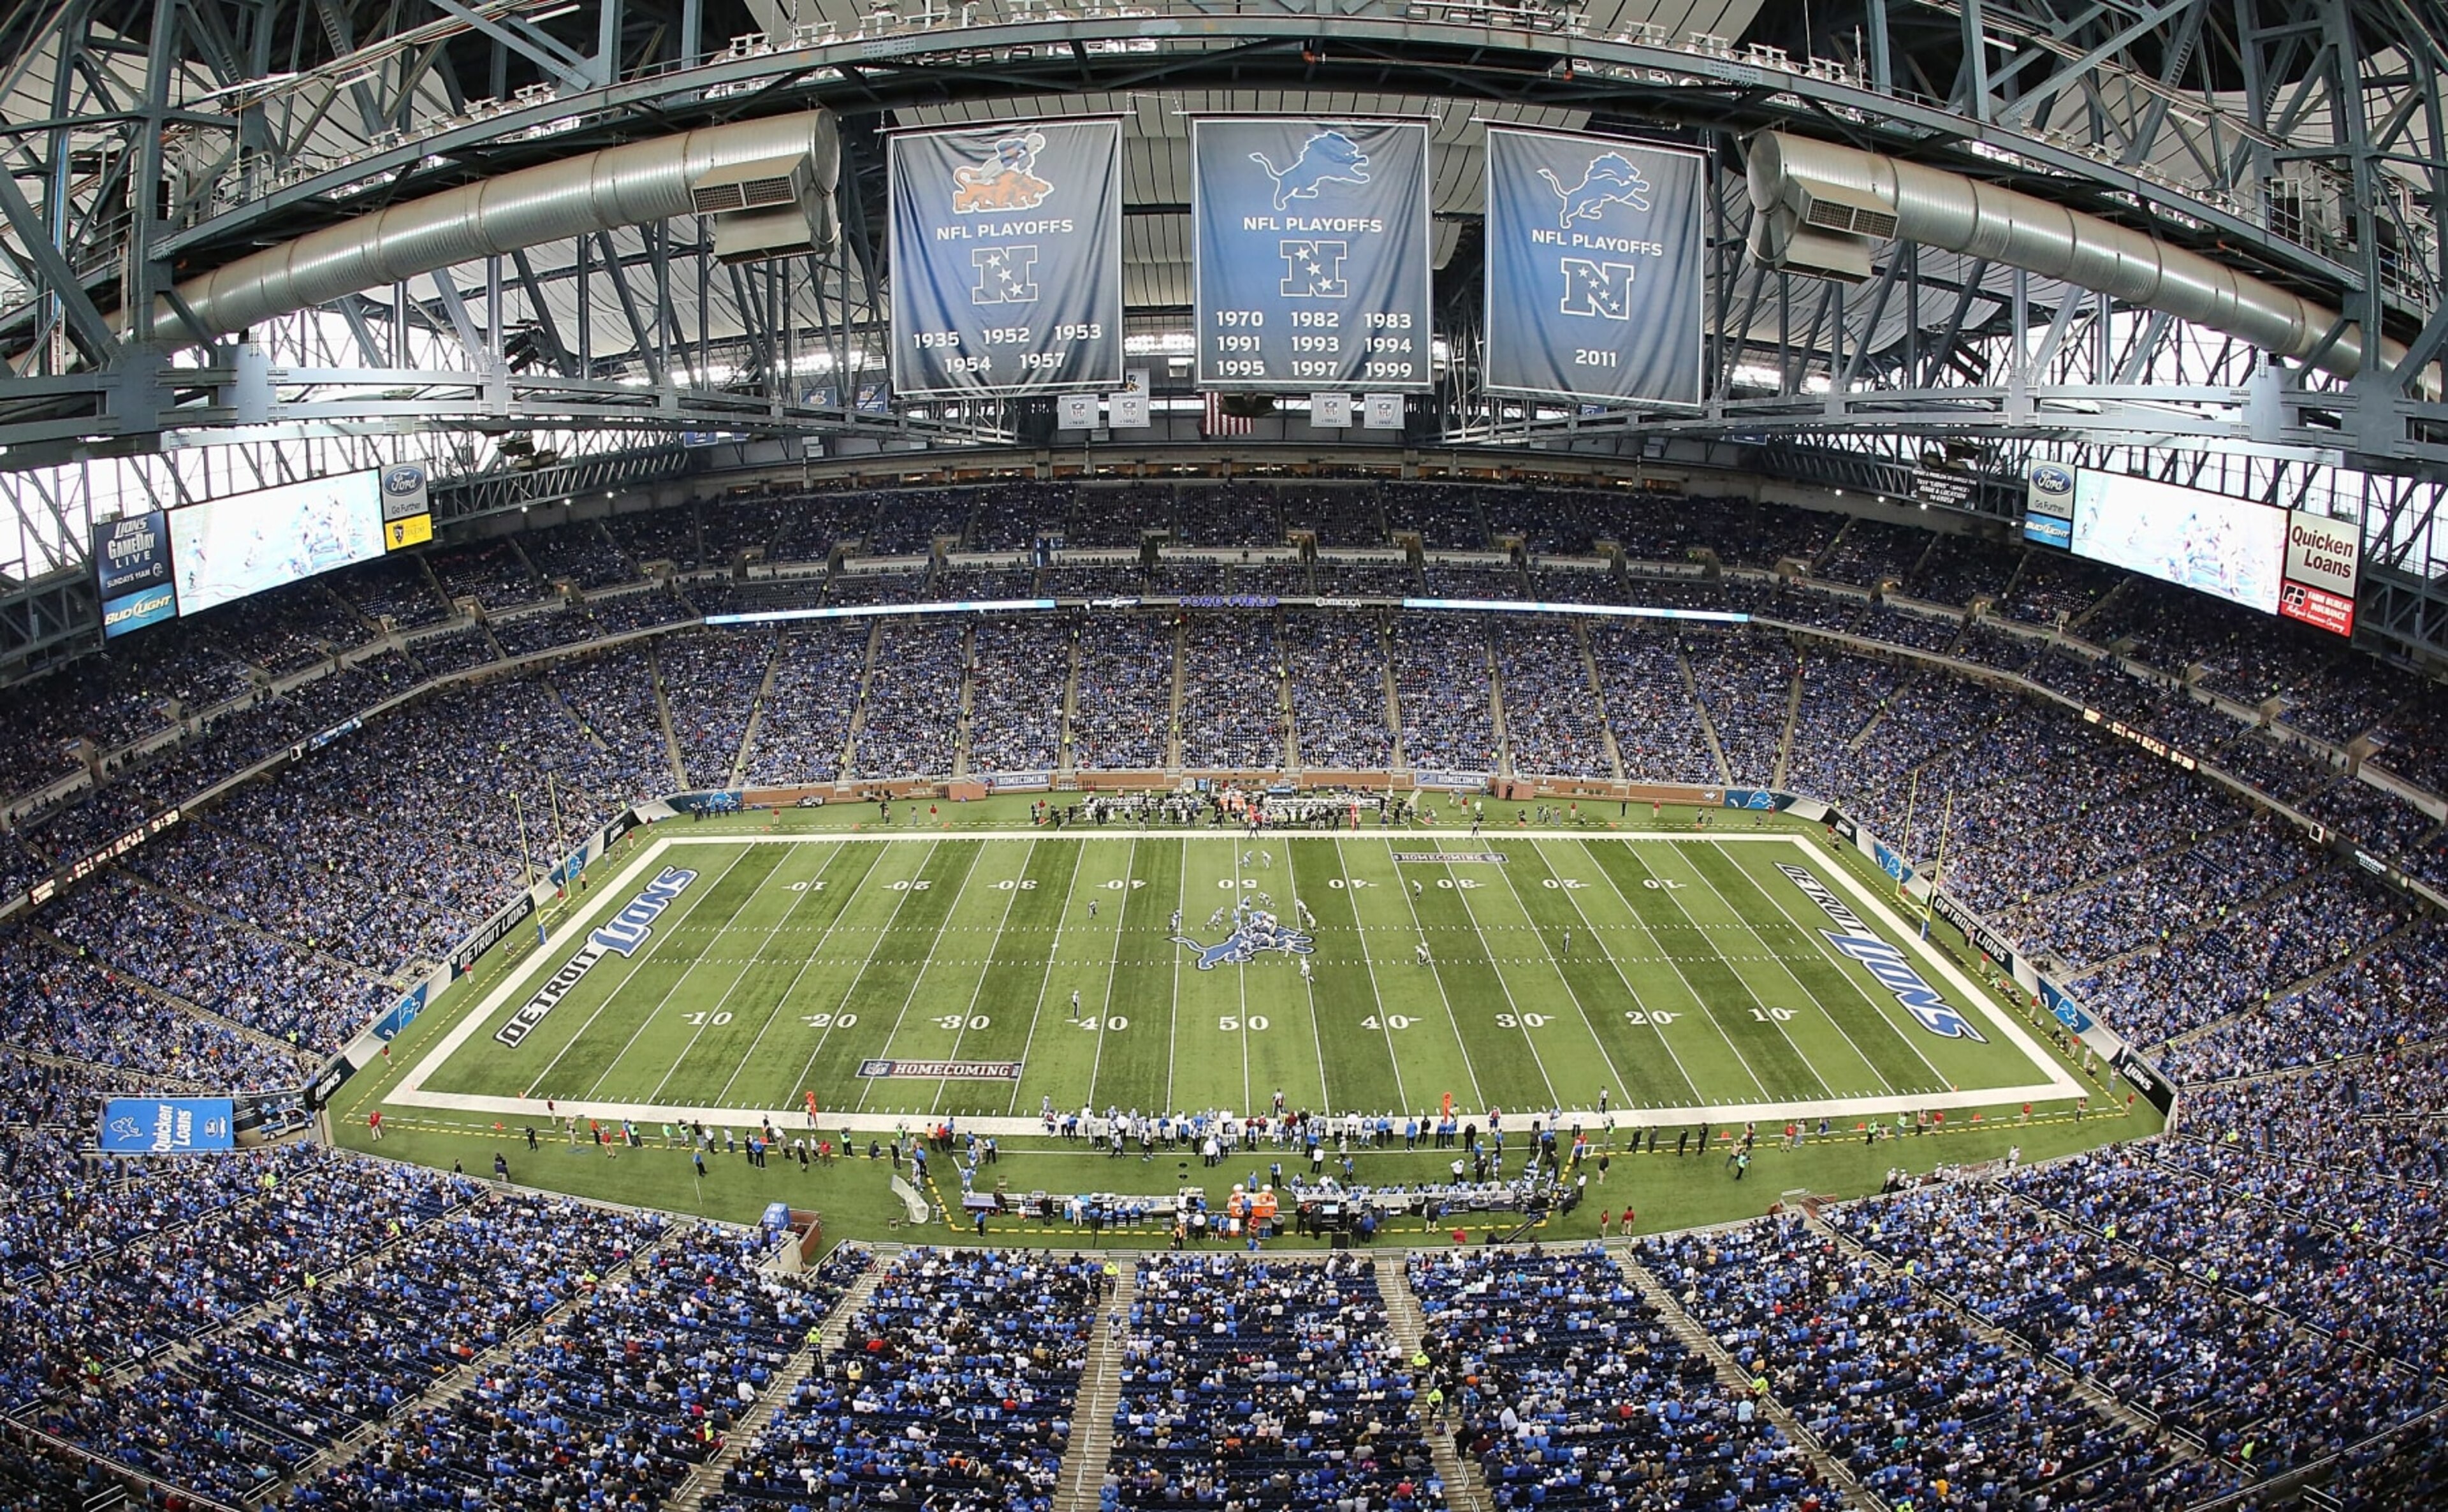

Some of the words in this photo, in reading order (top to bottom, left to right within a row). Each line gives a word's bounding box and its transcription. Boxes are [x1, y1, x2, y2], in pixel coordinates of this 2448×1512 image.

[936, 224, 973, 240] NFL
[977, 219, 1074, 237] PLAYOFFS
[1243, 217, 1281, 232] NFL
[1285, 217, 1383, 233] PLAYOFFS
[1532, 229, 1567, 246] NFL
[1572, 233, 1663, 256] PLAYOFFS
[1216, 311, 1264, 328] 1970
[1291, 312, 1339, 329] 1982
[1364, 312, 1412, 330] 1983
[913, 331, 959, 348] 1935
[982, 327, 1030, 345] 1952
[1054, 323, 1102, 340] 1953
[1216, 336, 1260, 353] 1991
[1291, 336, 1339, 353] 1993
[1364, 337, 1412, 354] 1994
[944, 356, 993, 374] 1954
[1019, 351, 1066, 370] 1957
[1575, 349, 1617, 367] 2011
[1217, 360, 1265, 377] 1995
[1291, 360, 1339, 377] 1997
[1365, 361, 1413, 378] 1999
[391, 472, 417, 491] Ford
[2038, 470, 2065, 491] Ford
[391, 505, 400, 514] Go
[400, 502, 421, 512] Further
[2044, 501, 2065, 513] Further
[114, 517, 147, 539] LIONS
[2025, 521, 2043, 531] BUD
[2044, 525, 2070, 538] LIGHT
[2291, 525, 2354, 558] Quicken
[115, 551, 151, 569] LIVE
[2303, 549, 2352, 578] Loans
[107, 573, 135, 588] SUNDAYS
[105, 608, 133, 626] BUD
[137, 595, 172, 614] LIGHT
[1179, 597, 1224, 606] FORD
[1228, 597, 1278, 606] FIELD
[998, 774, 1048, 785] HOMECOMING
[1784, 865, 1870, 934] DETROIT
[460, 922, 501, 970] DETROIT
[502, 899, 528, 933] LIONS
[500, 948, 599, 1043] DETROIT
[588, 866, 697, 957] LIONS
[1976, 931, 2008, 962] LIONS
[1818, 927, 1989, 1043] LIONS
[694, 1011, 732, 1027] 10
[809, 1012, 858, 1029] 20
[939, 1014, 991, 1030] 30
[1079, 1015, 1129, 1031] 40
[1218, 1015, 1269, 1031] 50
[1360, 1014, 1410, 1030] 40
[1496, 1012, 1545, 1029] 30
[1626, 1010, 1674, 1026] 20
[1751, 1007, 1793, 1022] 10
[893, 1063, 1010, 1077] HOMECOMING
[2122, 1061, 2153, 1091] LIONS
[315, 1068, 341, 1101] LIONS
[151, 1105, 173, 1152] Quicken
[173, 1109, 192, 1146] Loans
